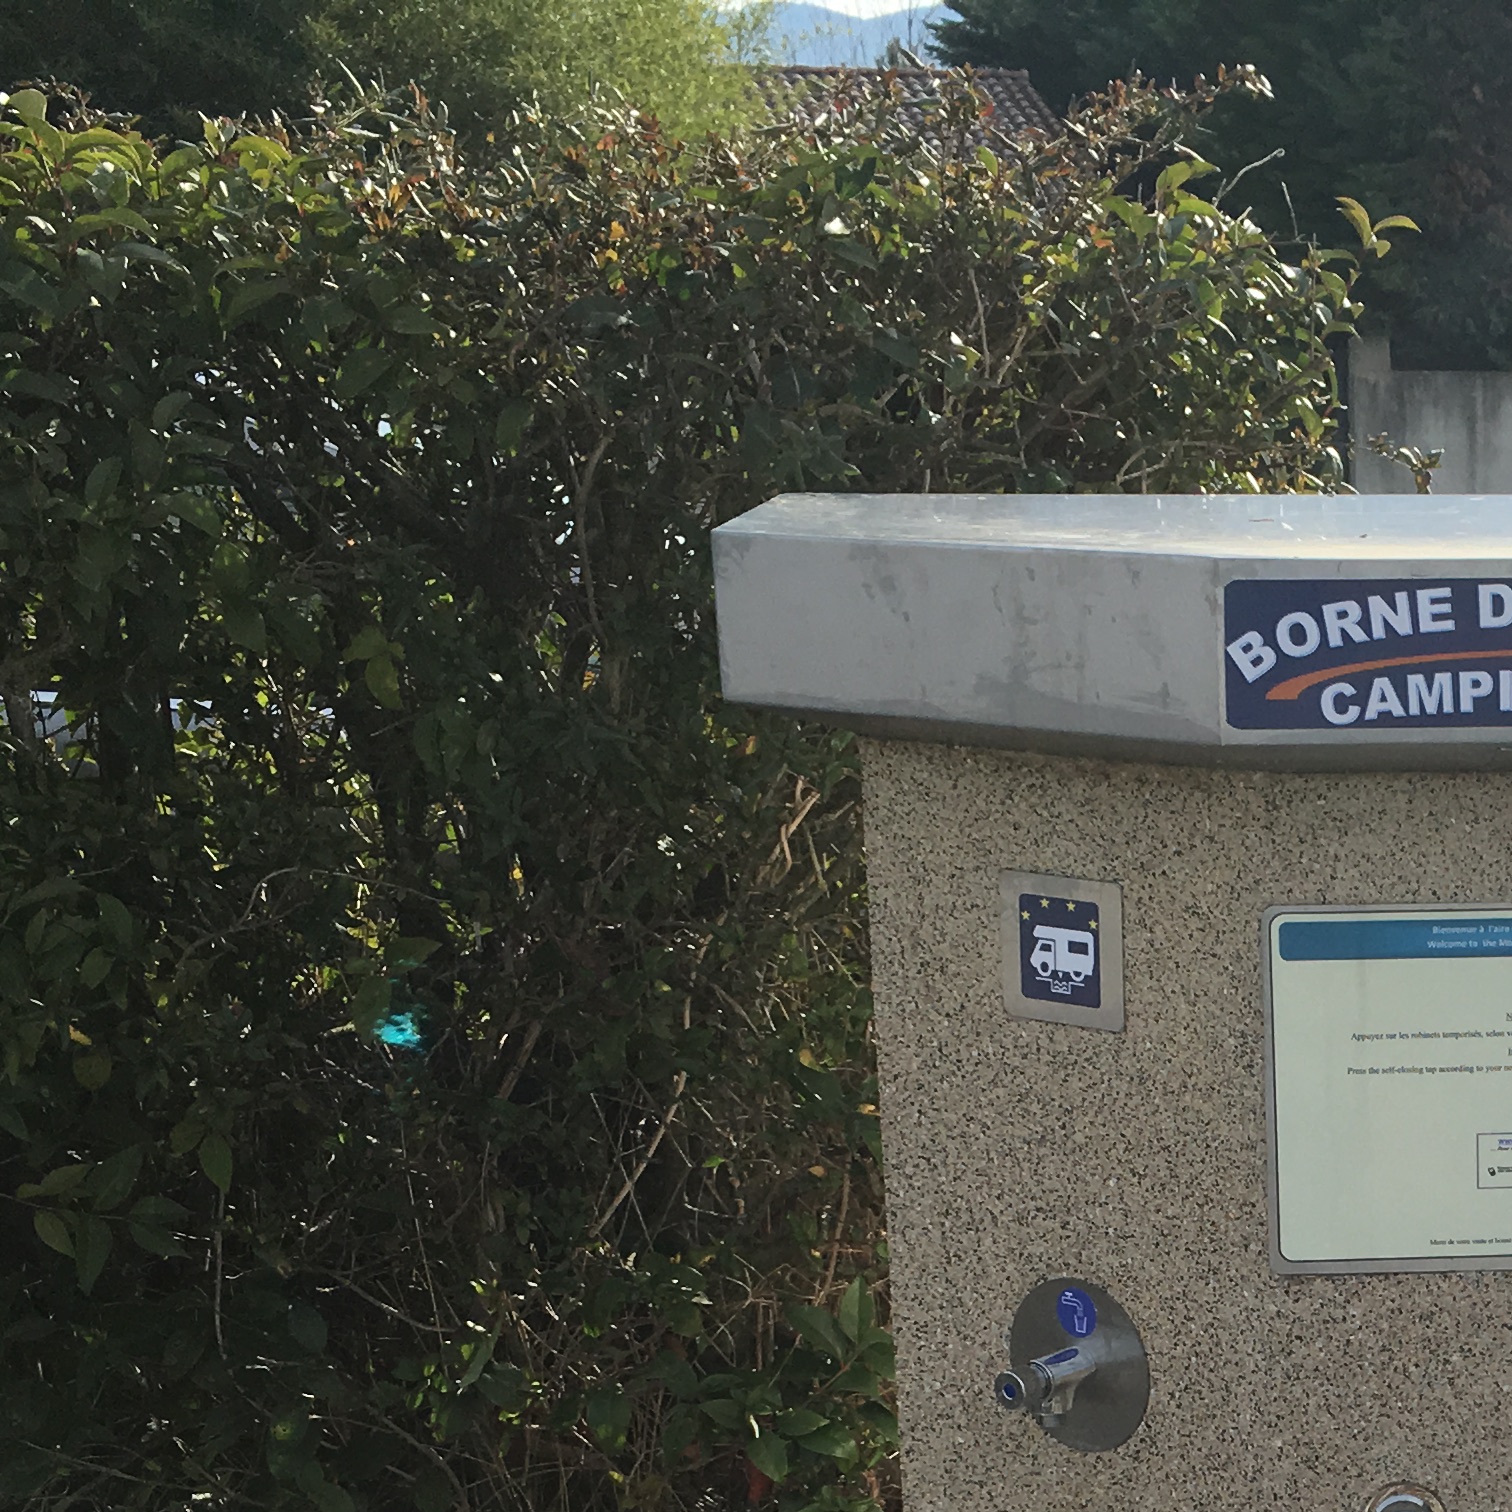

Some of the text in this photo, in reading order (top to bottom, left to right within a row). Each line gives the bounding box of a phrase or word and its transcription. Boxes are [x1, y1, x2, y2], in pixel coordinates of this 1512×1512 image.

[1226, 587, 1456, 683] BORNE
[1427, 939, 1467, 948] Welcome
[1469, 939, 1478, 947] to
[1482, 939, 1497, 947] the
[1351, 1032, 1383, 1042] Appuyez
[1399, 1031, 1410, 1039] les
[1411, 1031, 1441, 1040] robinets
[1486, 1029, 1505, 1038] selon
[1347, 1067, 1367, 1075] Press
[1368, 1066, 1380, 1075] the
[1381, 1065, 1424, 1075] self-closing
[1425, 1066, 1437, 1075] tap
[1439, 1064, 1475, 1074] according
[1485, 1065, 1503, 1073] your
